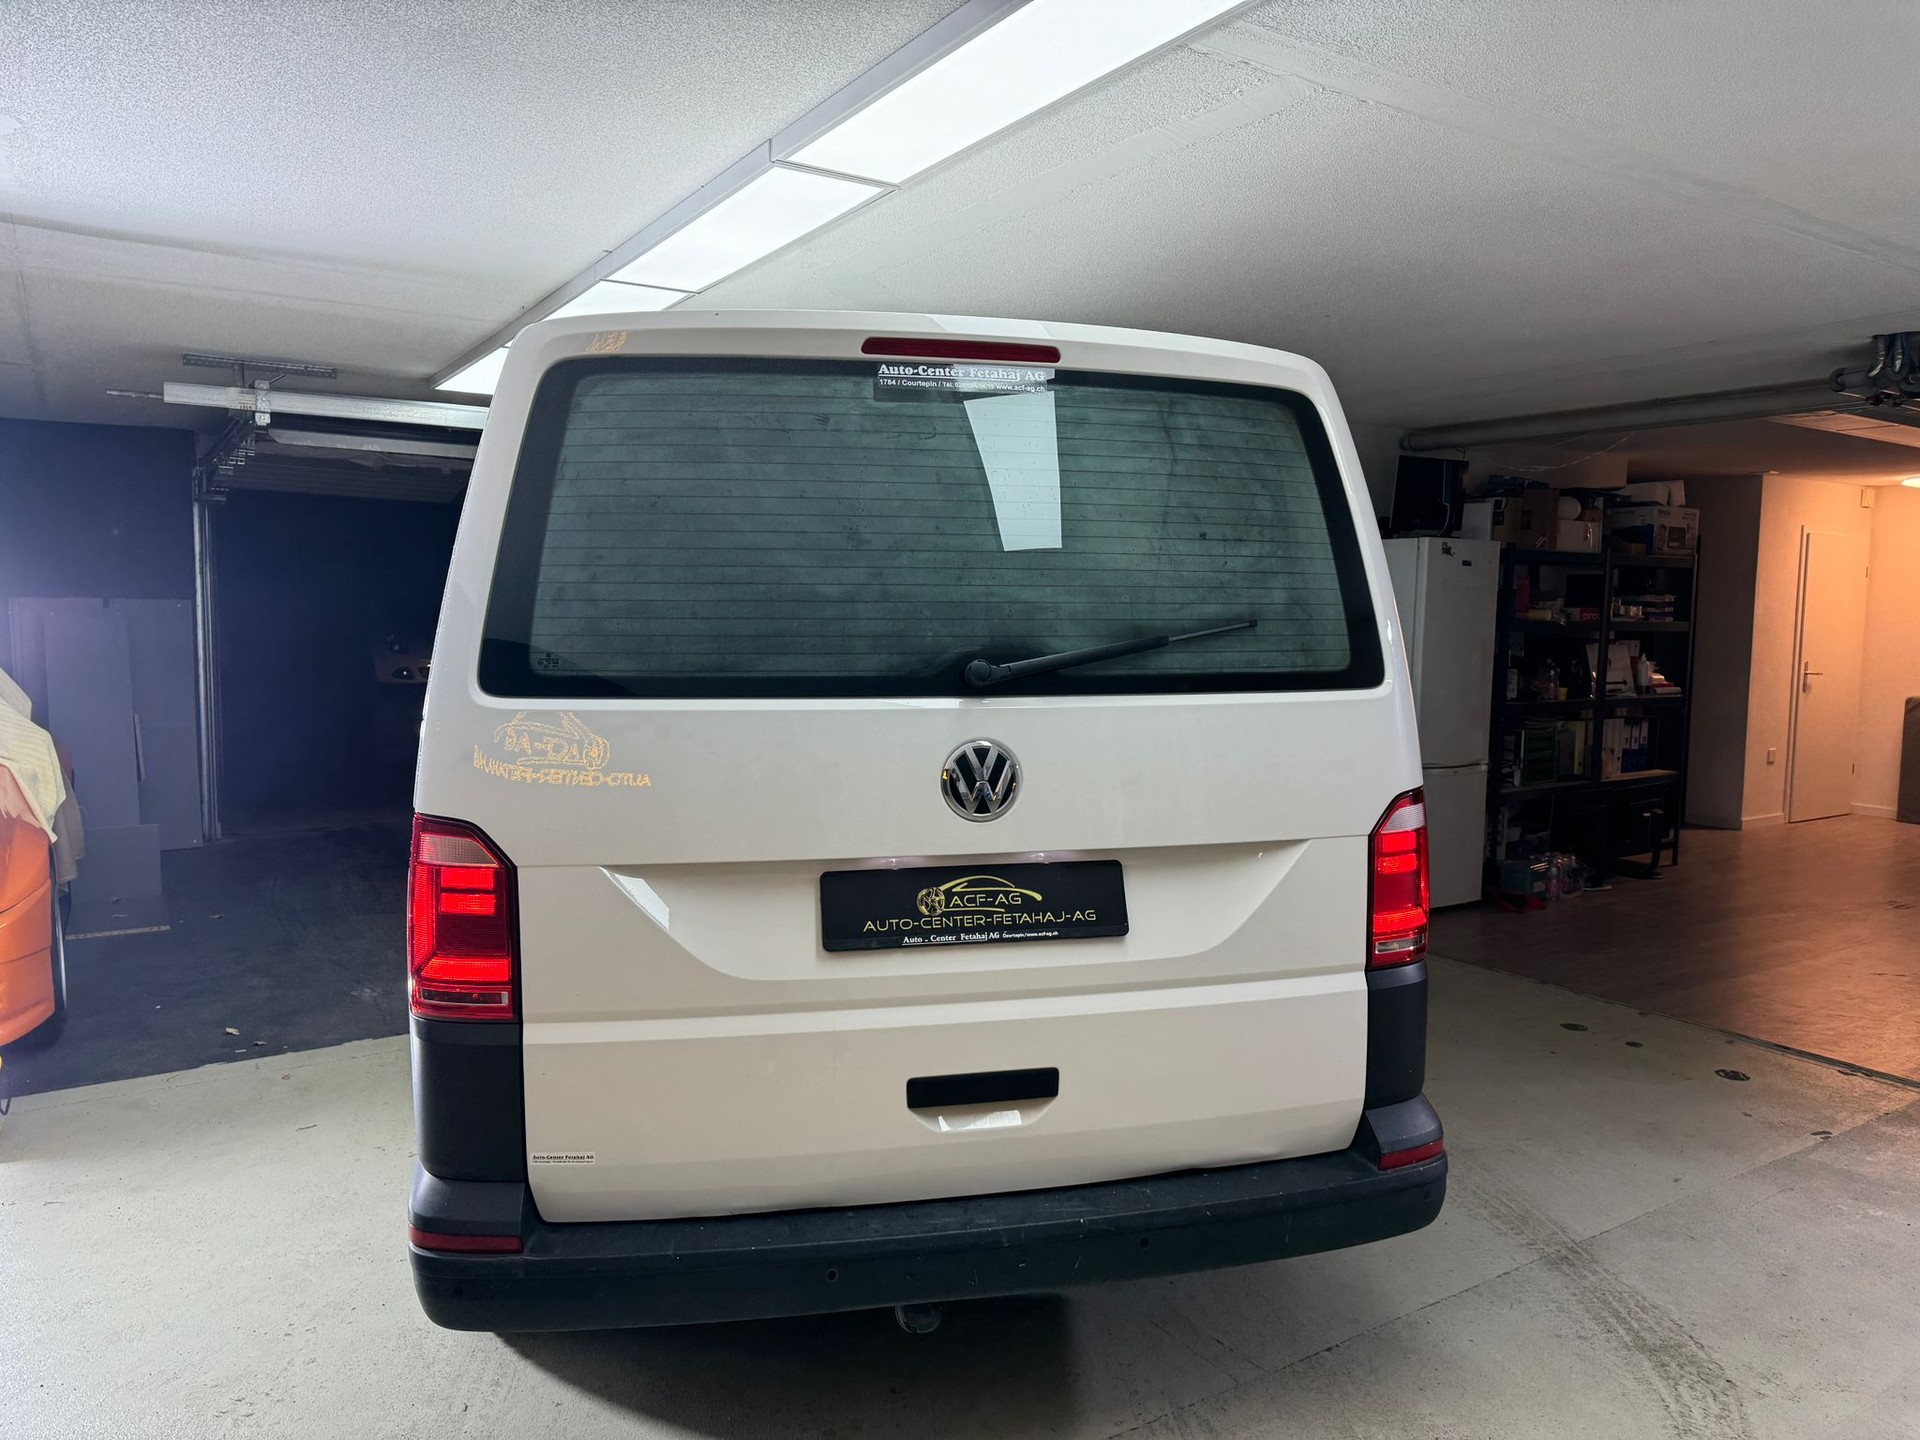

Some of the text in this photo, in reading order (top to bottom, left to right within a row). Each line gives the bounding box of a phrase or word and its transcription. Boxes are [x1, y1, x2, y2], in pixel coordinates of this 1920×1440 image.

[877, 364, 1046, 381] Auto-Center Fetahaj AG
[902, 380, 937, 388] Courtepin
[949, 892, 1022, 908] ACF-AG
[862, 910, 1097, 933] AUTO-CENTER-FETAHAJ-AG
[903, 936, 923, 944] Auto
[930, 934, 957, 942] Center
[960, 932, 988, 941] Fetahaj
